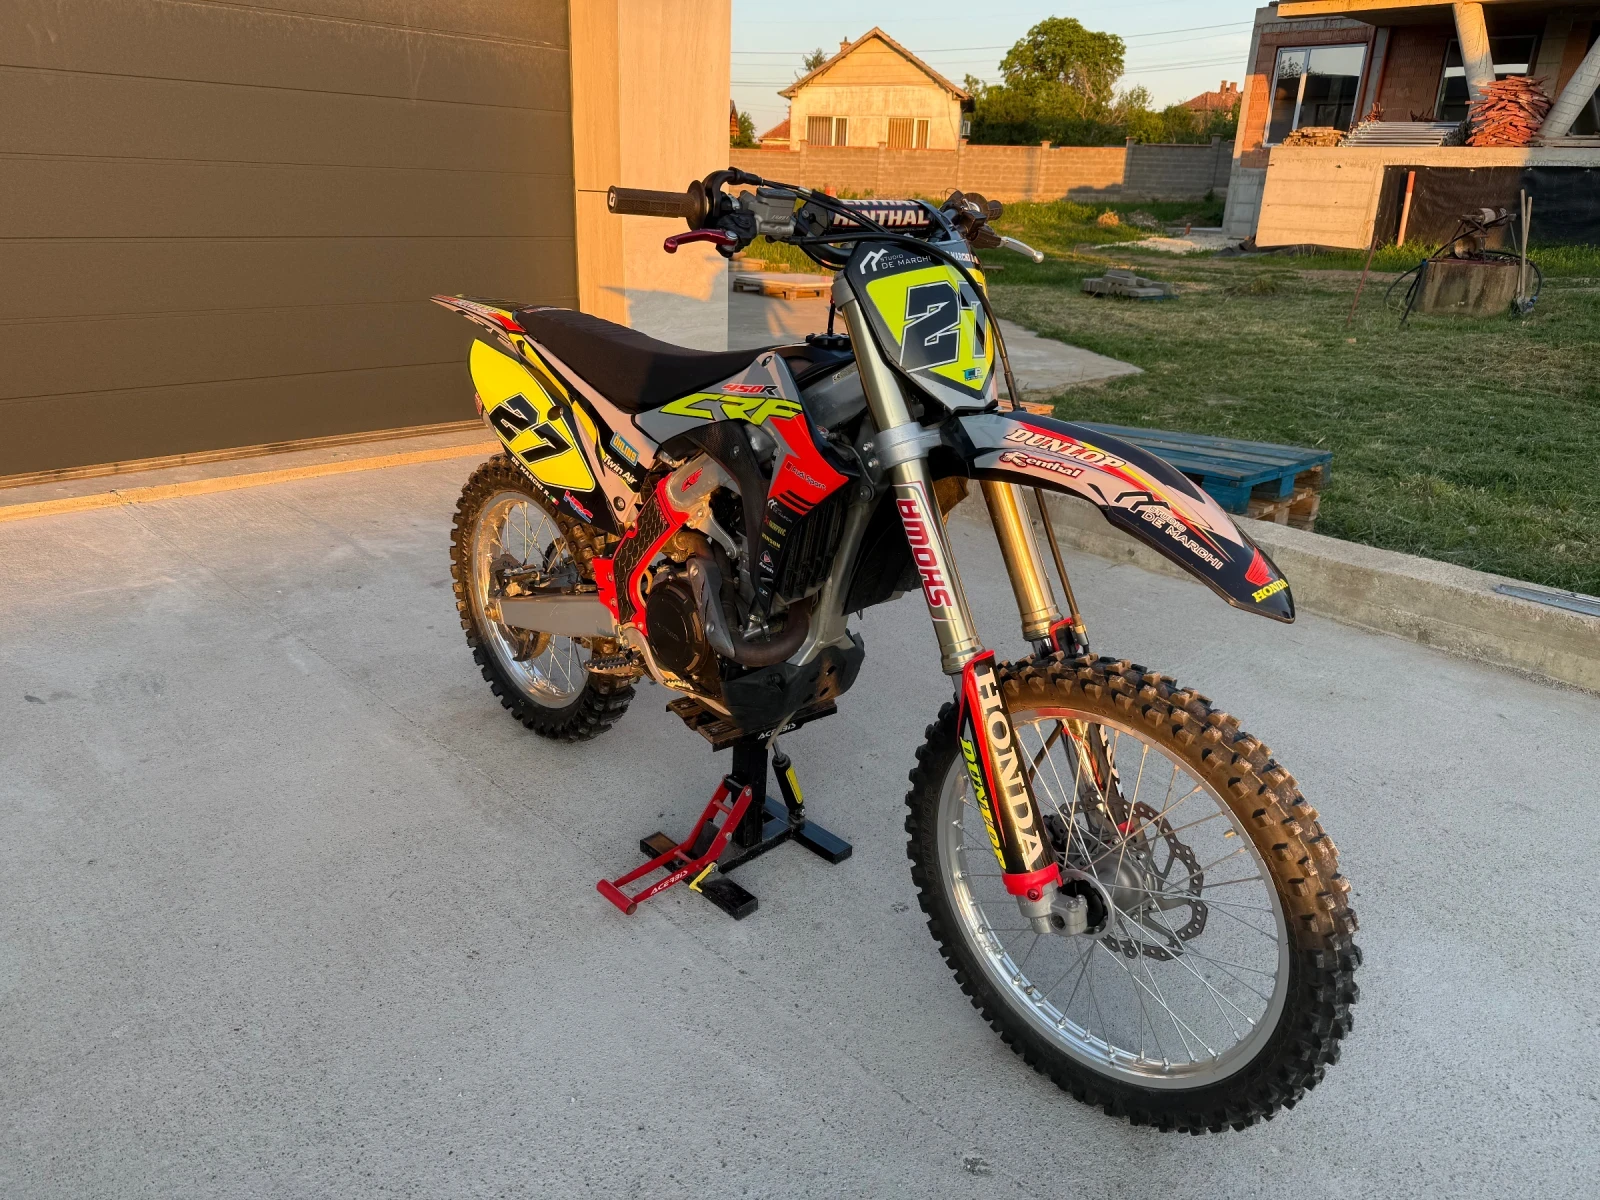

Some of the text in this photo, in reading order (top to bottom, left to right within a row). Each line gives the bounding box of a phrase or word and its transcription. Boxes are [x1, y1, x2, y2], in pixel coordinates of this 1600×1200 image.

[879, 254, 904, 262] STUDIO
[882, 255, 931, 270] DE MARCHI
[721, 383, 778, 397] 450R
[659, 391, 803, 427] CRF
[488, 391, 574, 465] 27
[1000, 451, 1083, 478] Renthal
[1003, 428, 1126, 468] DUNLOP
[511, 456, 520, 467] DE
[520, 465, 544, 491] MARCHI
[603, 453, 624, 476] Twin
[622, 471, 638, 484] Air
[1149, 506, 1186, 533] STUDIO
[896, 499, 952, 607] SHOWA
[1141, 510, 1224, 570] DE MARCHI
[1252, 578, 1288, 603] HONDA
[975, 667, 1044, 871] HONDA
[960, 736, 1007, 869] DUNLOP
